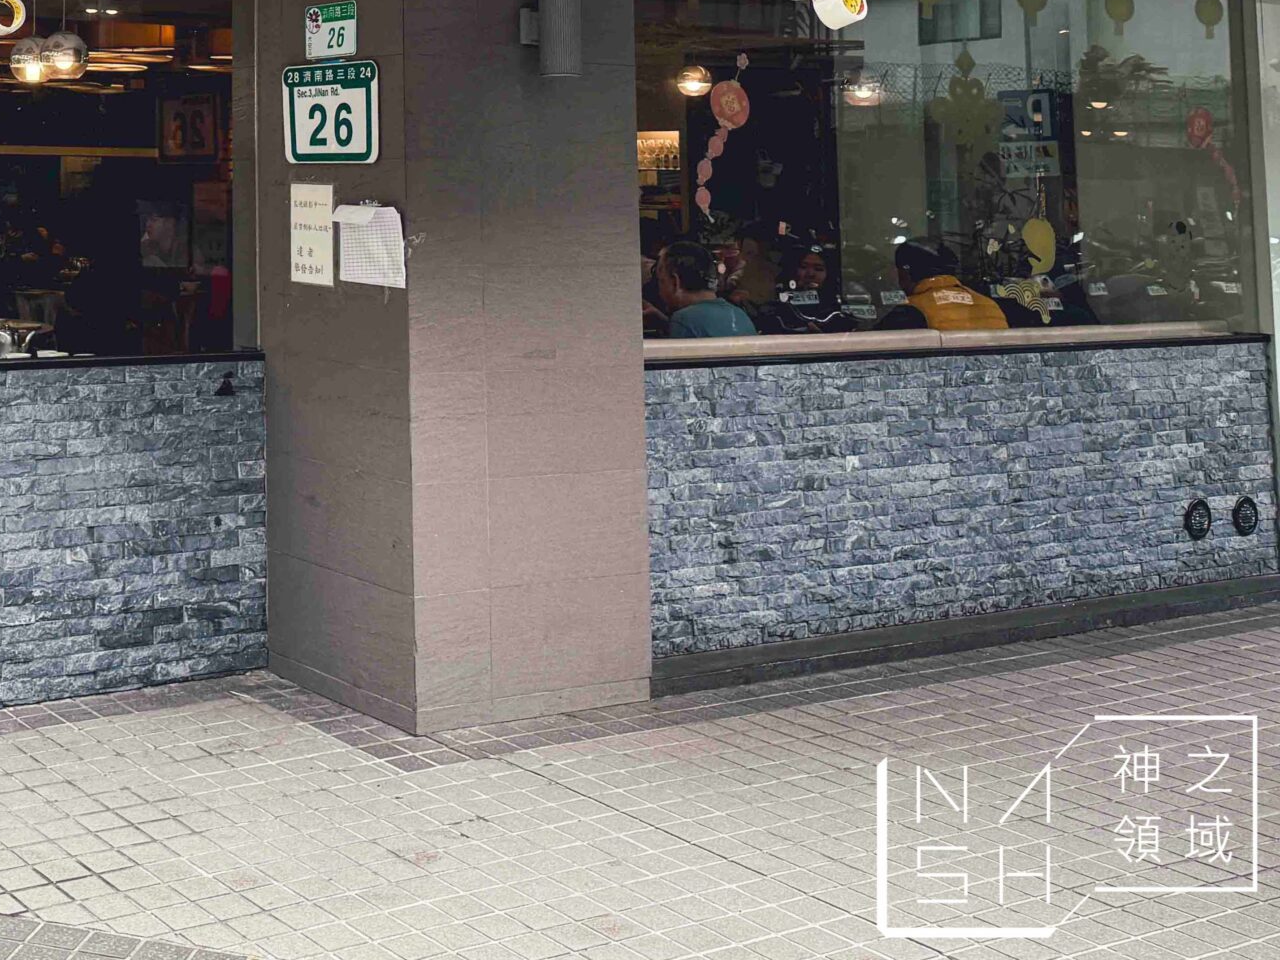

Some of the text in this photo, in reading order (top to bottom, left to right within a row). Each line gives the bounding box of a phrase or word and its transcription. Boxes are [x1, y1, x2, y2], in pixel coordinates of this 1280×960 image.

[327, 26, 345, 49] 26
[287, 67, 372, 84] 28 濟南路三段 24
[330, 86, 340, 97] Rd.
[308, 102, 354, 148] 26
